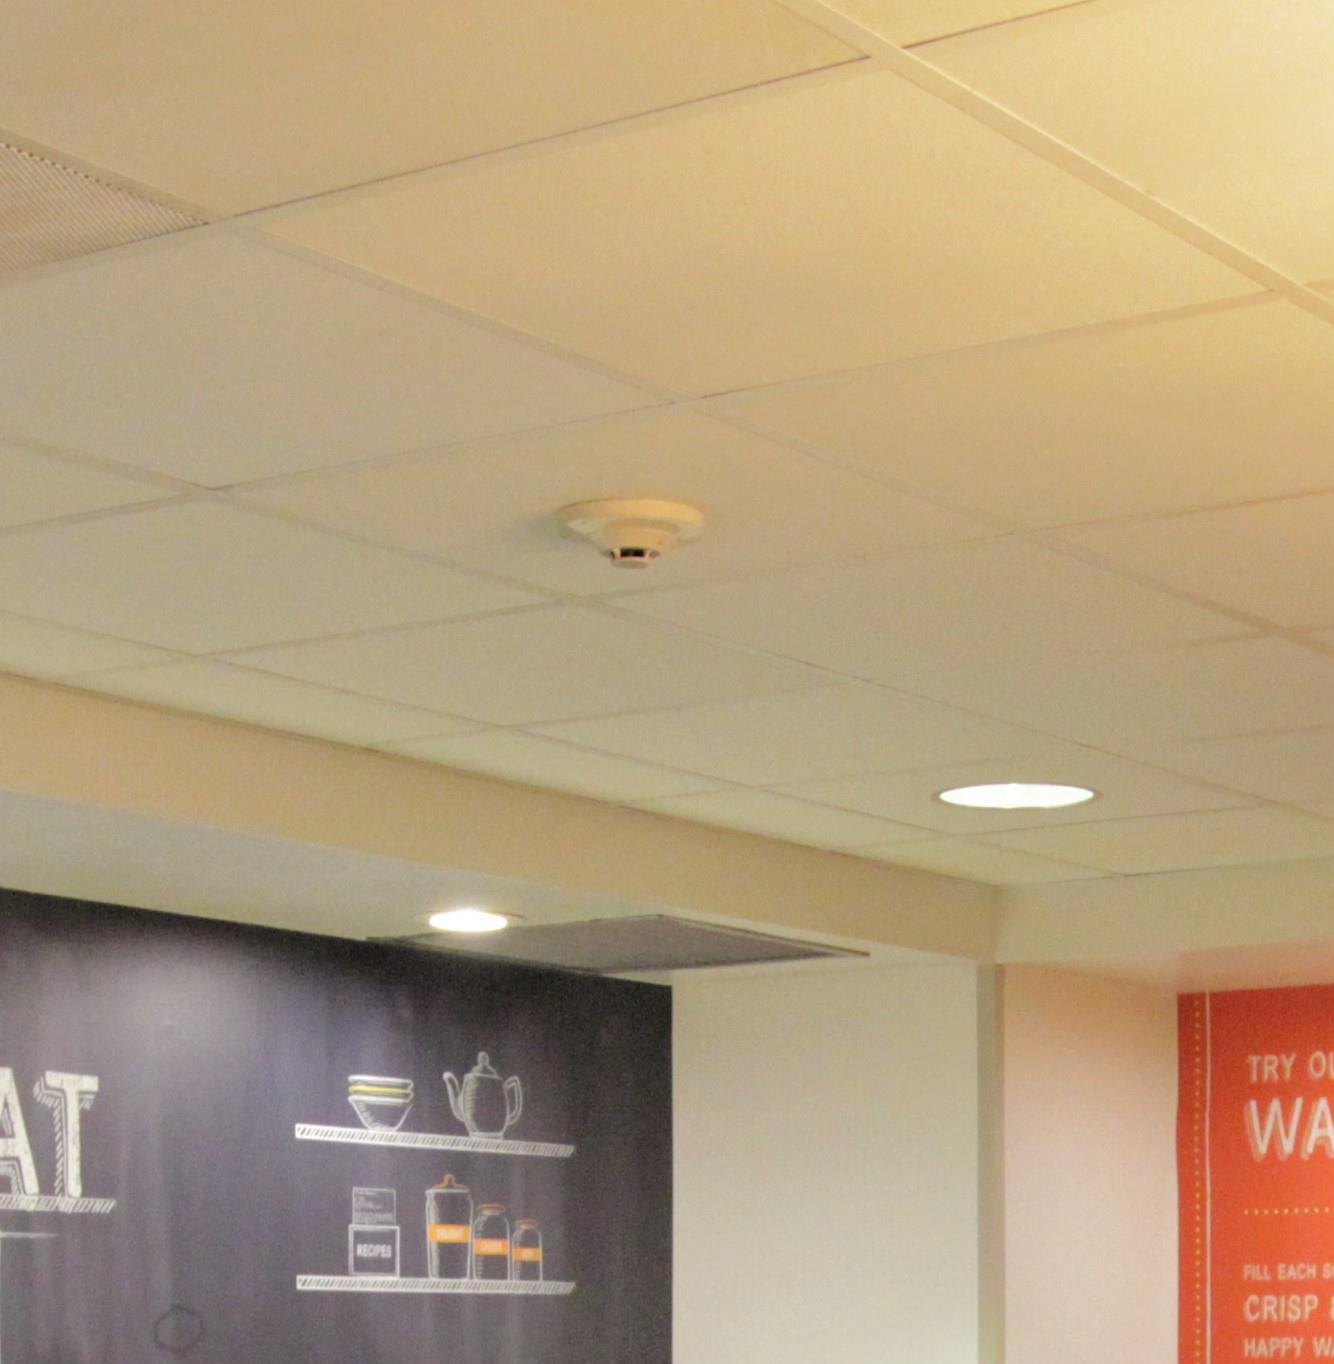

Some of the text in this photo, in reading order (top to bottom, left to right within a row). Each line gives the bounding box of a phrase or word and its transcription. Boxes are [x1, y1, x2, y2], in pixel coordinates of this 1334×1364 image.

[1247, 1053, 1295, 1083] TRY
[356, 1243, 392, 1259] RECIPES
[1243, 1264, 1271, 1281] FILL
[1277, 1263, 1317, 1280] EACH
[1243, 1293, 1319, 1323] CRISP
[1243, 1337, 1304, 1358] HAPPY
